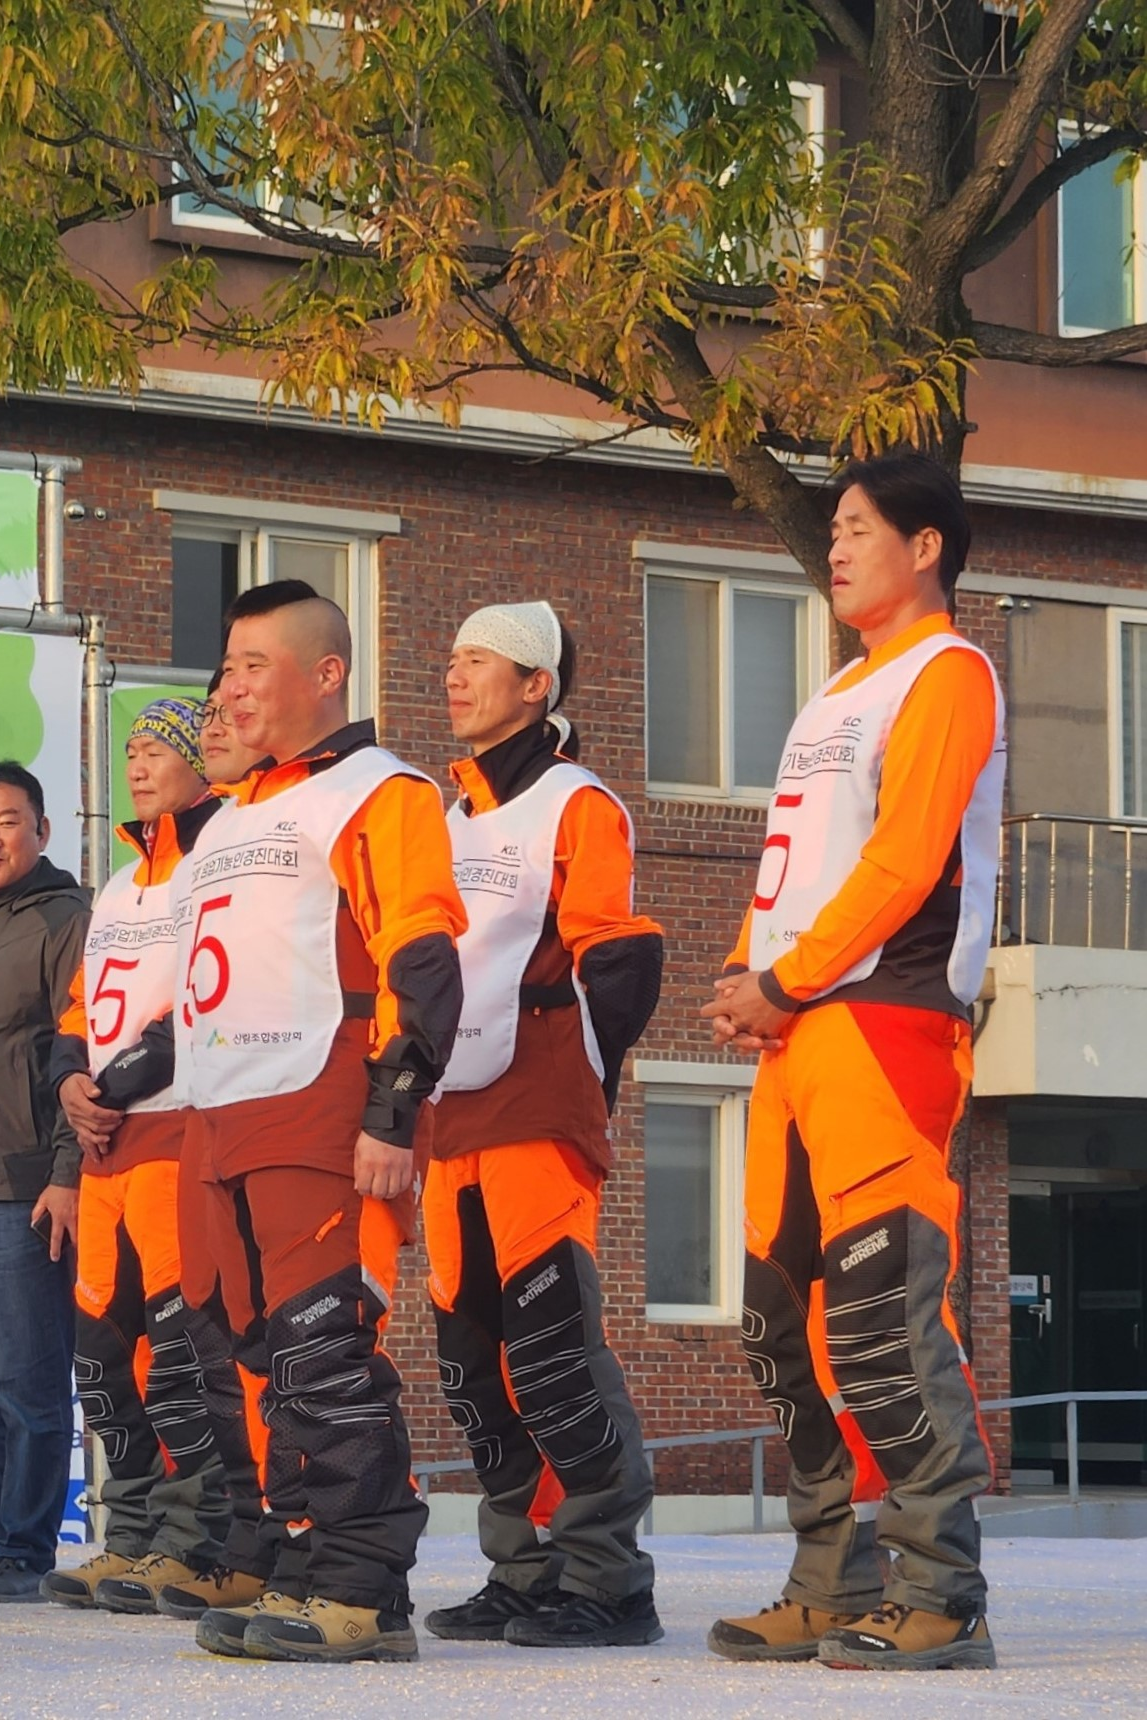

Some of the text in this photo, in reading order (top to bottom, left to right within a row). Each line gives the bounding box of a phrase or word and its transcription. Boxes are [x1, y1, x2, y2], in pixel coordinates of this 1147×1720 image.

[191, 894, 232, 1015] 5
[90, 957, 140, 1046] 5
[840, 1234, 890, 1273] EXTREME
